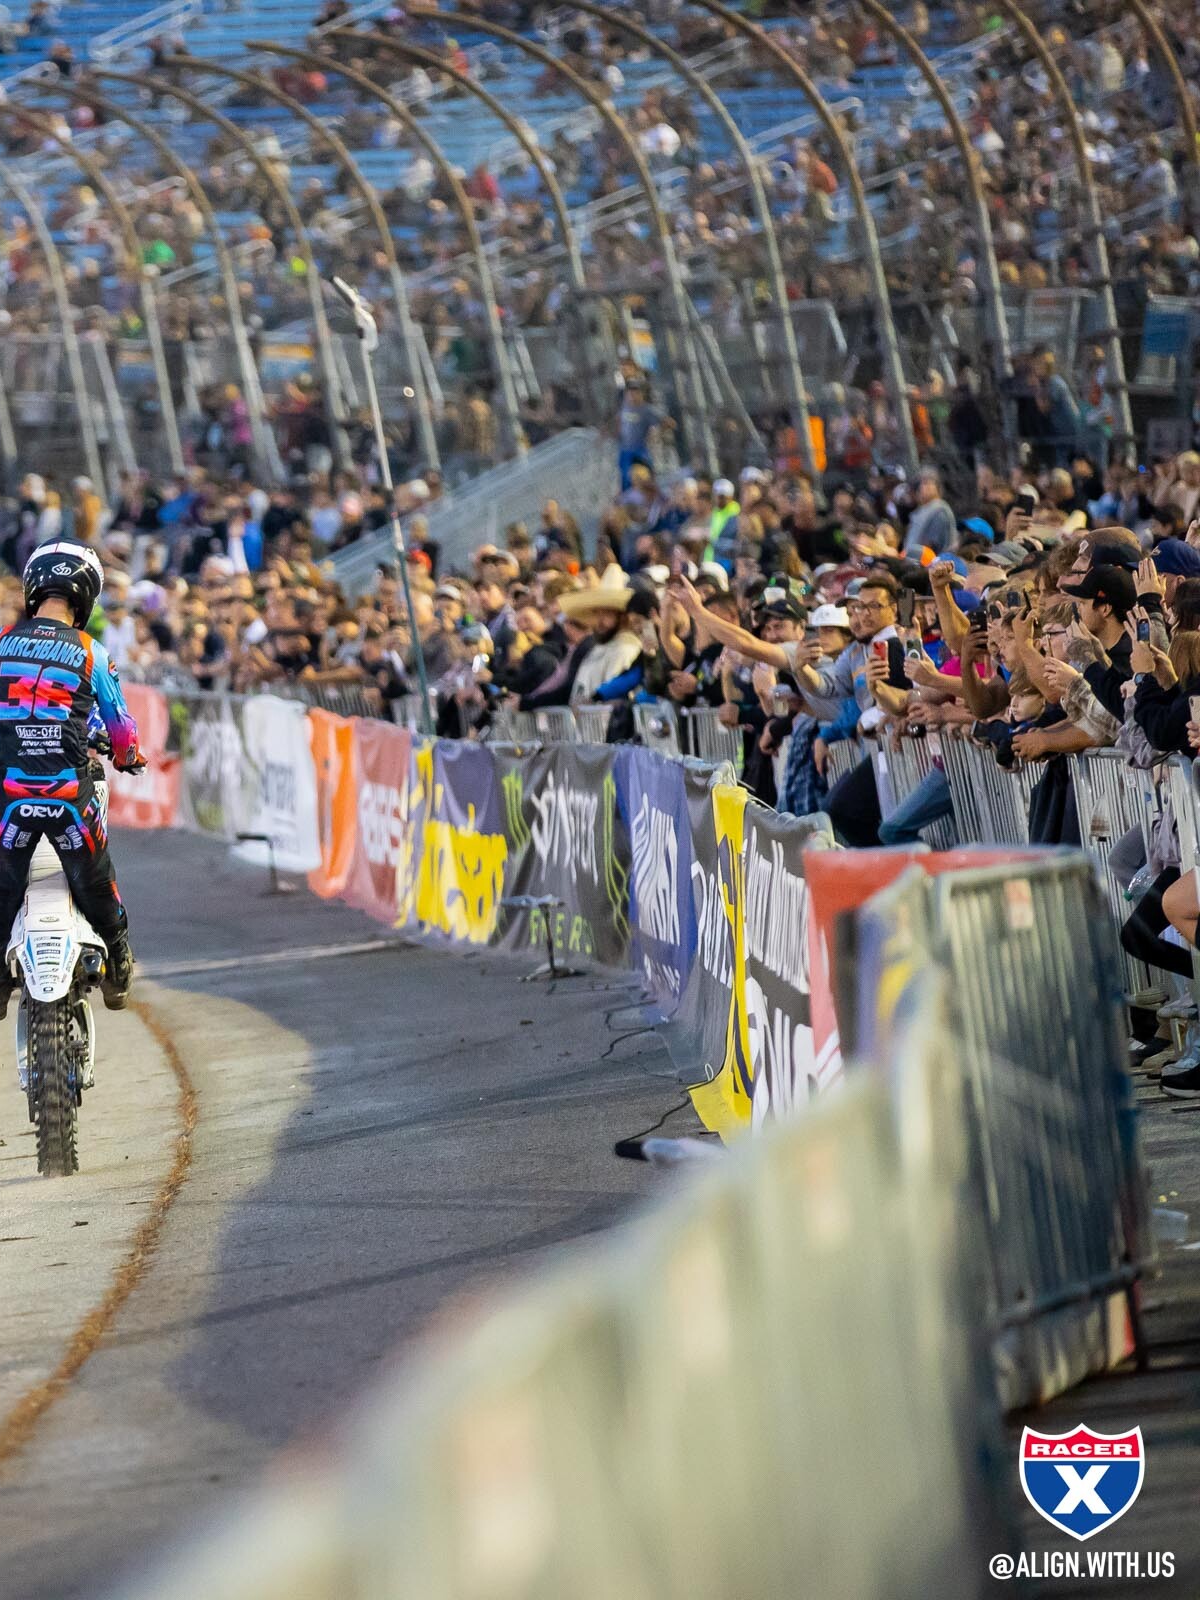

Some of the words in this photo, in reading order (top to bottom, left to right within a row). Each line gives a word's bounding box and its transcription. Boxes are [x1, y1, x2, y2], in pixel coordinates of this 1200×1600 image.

[33, 628, 57, 638] FXR
[17, 725, 59, 738] Muc-Off
[19, 804, 65, 819] ORW
